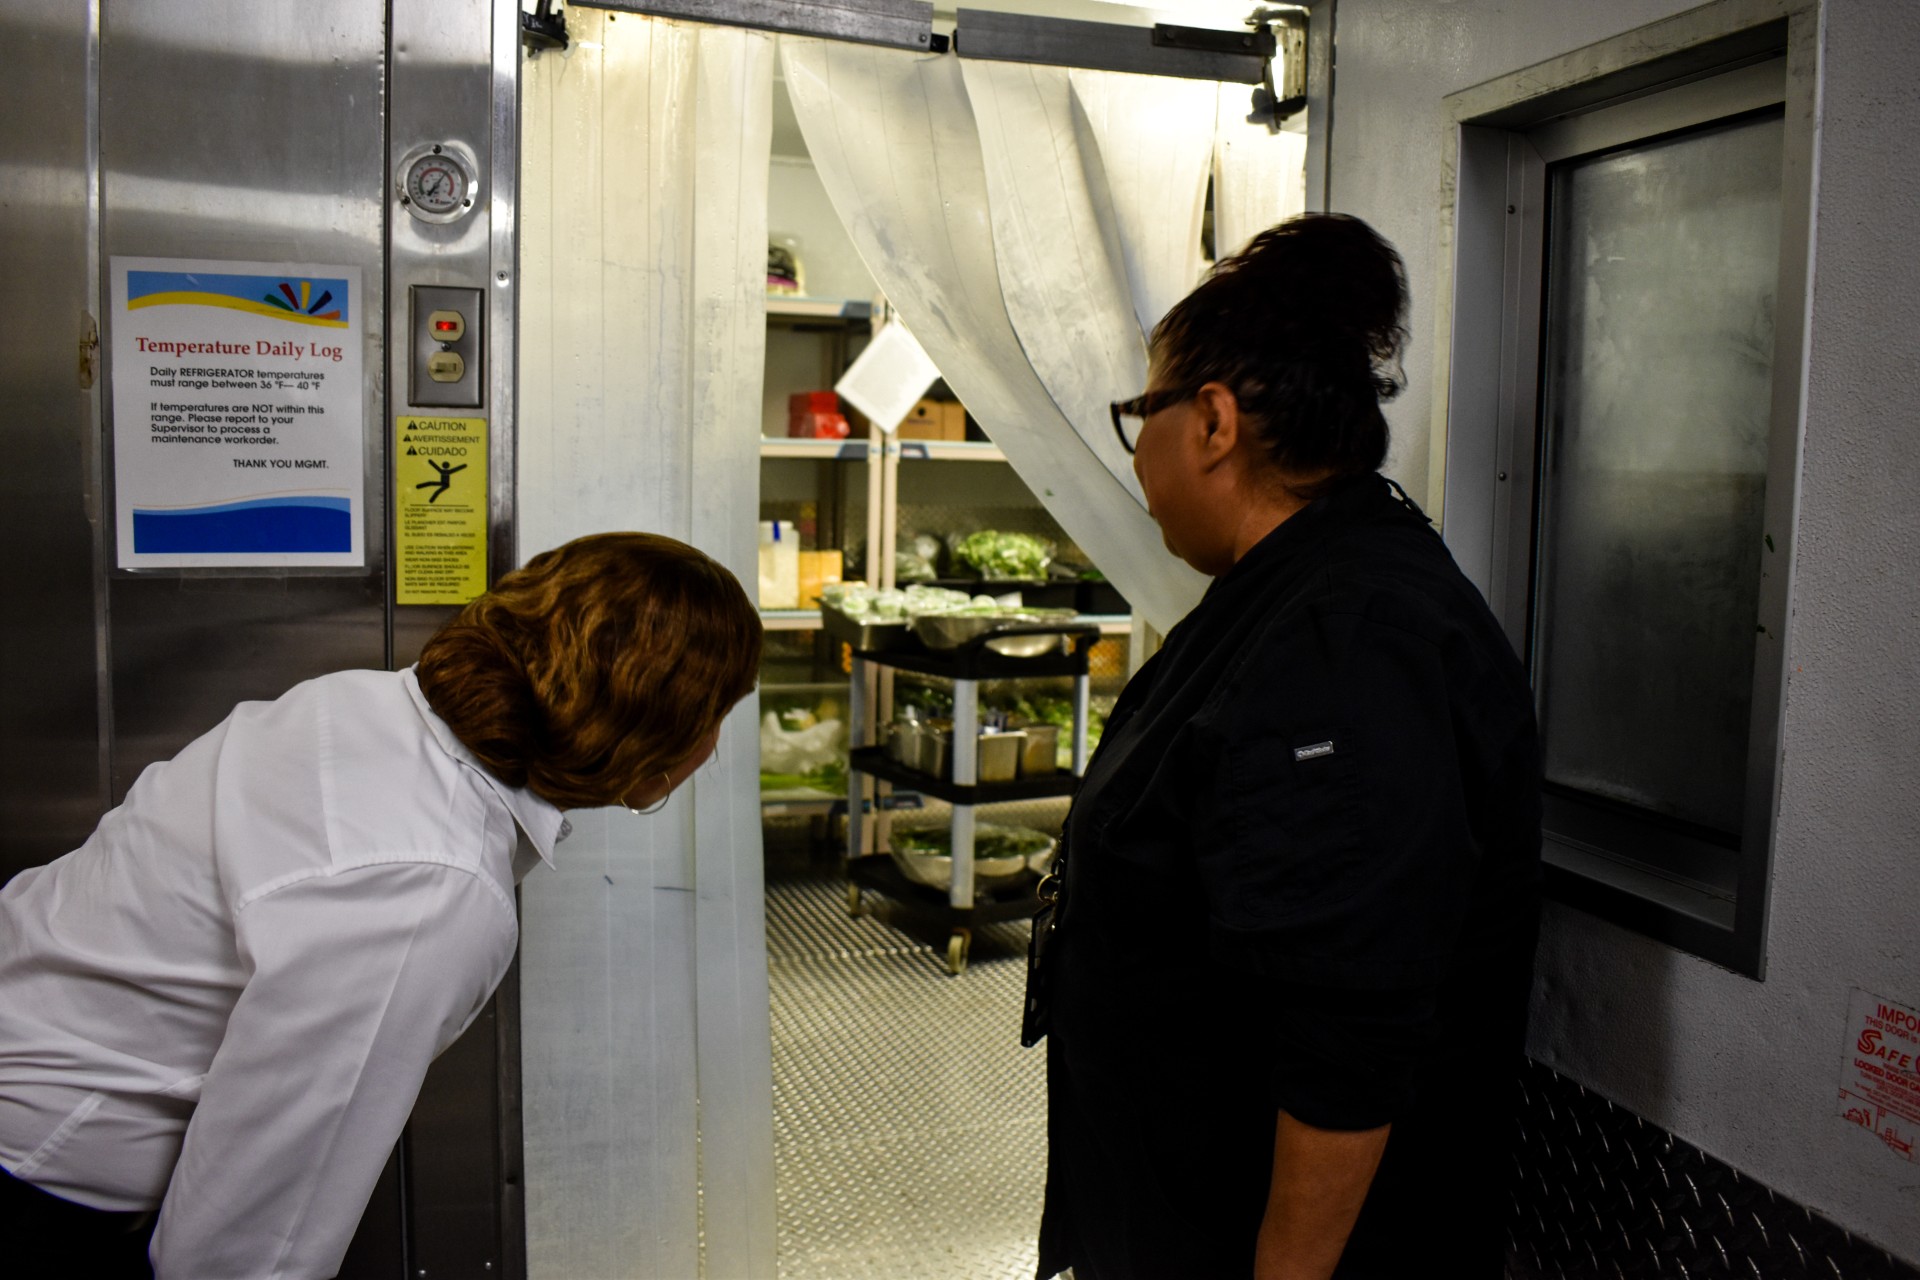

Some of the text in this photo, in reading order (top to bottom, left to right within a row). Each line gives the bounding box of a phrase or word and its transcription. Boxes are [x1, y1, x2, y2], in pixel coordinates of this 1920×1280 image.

[135, 337, 343, 362] Temperature Daily Log
[150, 366, 325, 381] Daily REFRIGERATOR temperatures
[150, 378, 175, 387] must
[178, 380, 209, 390] range
[211, 379, 257, 389] between
[260, 380, 272, 389] 36
[296, 382, 309, 390] 40
[150, 402, 157, 411] If
[160, 402, 230, 414] temperatures
[252, 404, 274, 413] NOT
[276, 405, 305, 414] within
[308, 405, 325, 414] this
[151, 414, 294, 425] range. Please report to your
[151, 424, 205, 434] Supervisor
[207, 424, 218, 434] to
[220, 426, 261, 435] process
[418, 420, 467, 431] CAUTION
[152, 434, 279, 444] maintenance workorder.
[412, 435, 480, 444] AVERTISSEMENT
[418, 446, 468, 456] CUIDADO
[233, 459, 330, 468] THANK YOU MGMT.
[1877, 1003, 1920, 1034] IMPO
[1865, 1015, 1918, 1044] THIS DOOR is
